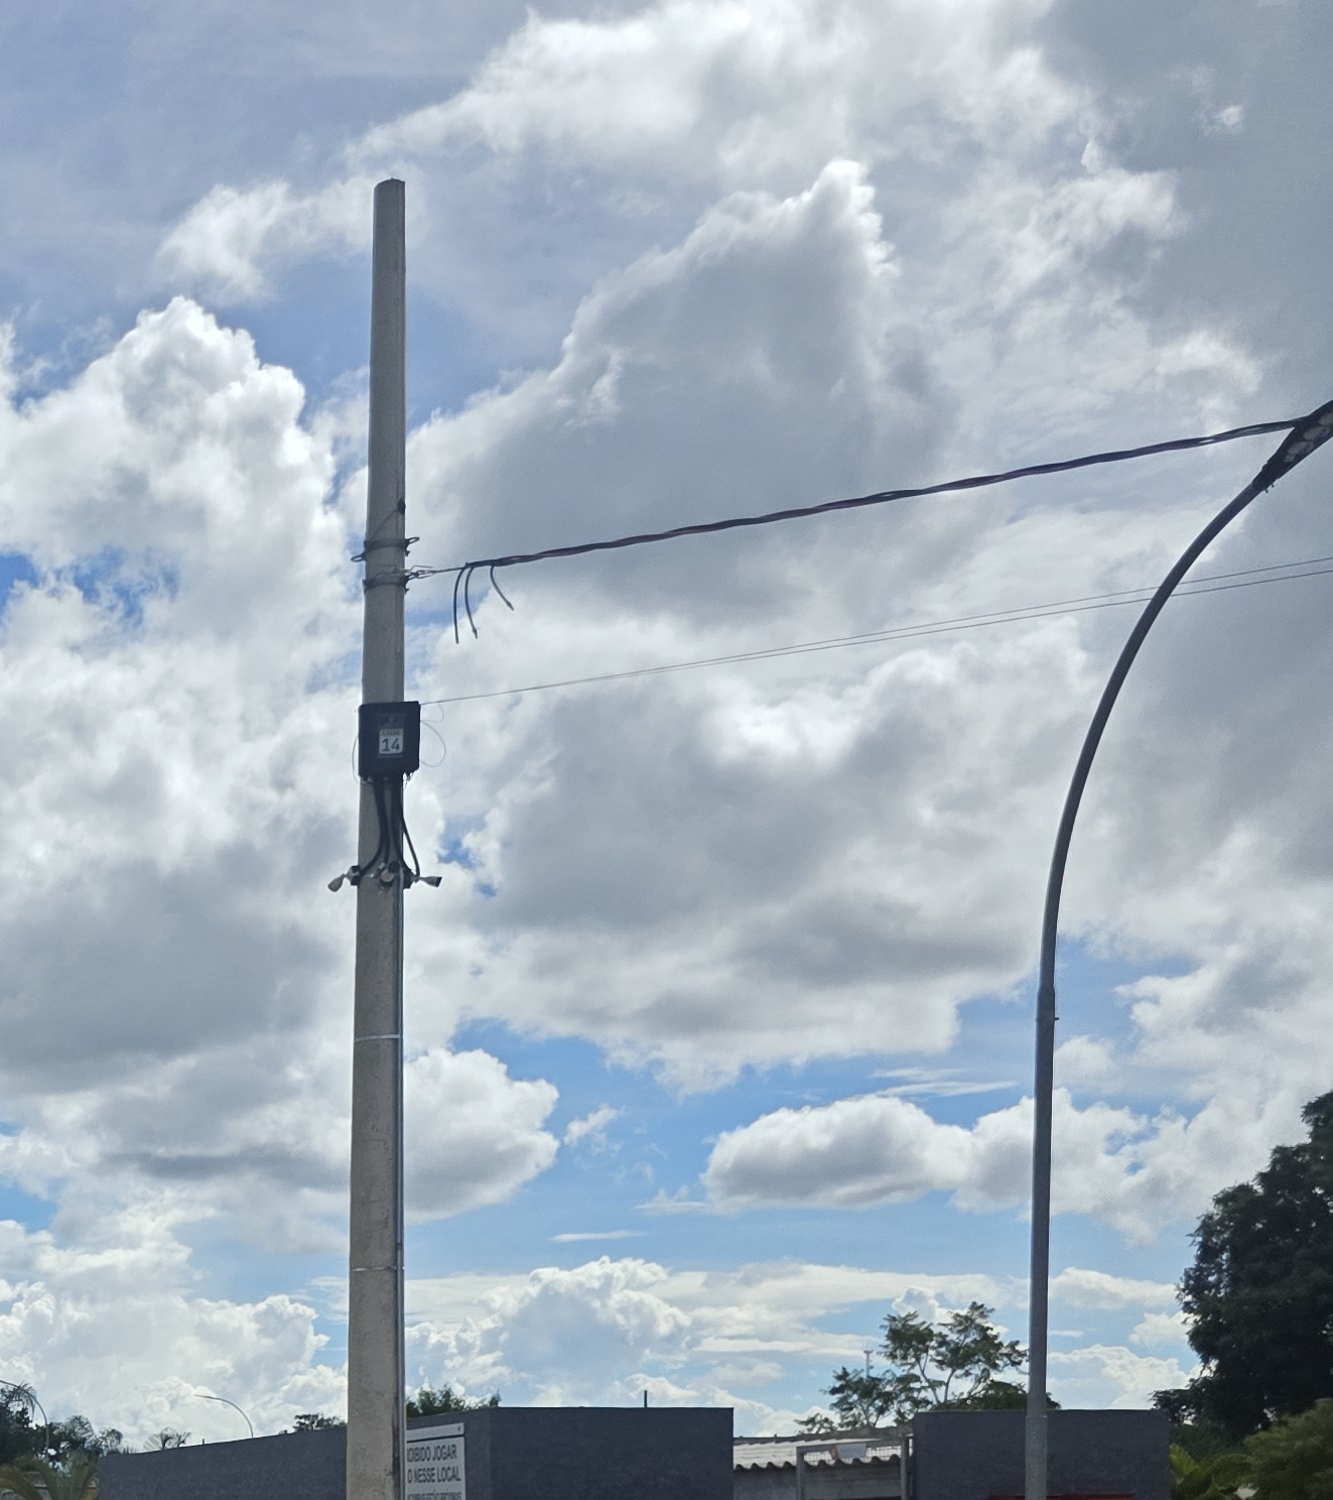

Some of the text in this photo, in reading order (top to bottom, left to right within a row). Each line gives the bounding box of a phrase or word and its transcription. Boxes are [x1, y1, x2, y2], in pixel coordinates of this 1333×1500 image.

[381, 738, 400, 752] 14
[407, 1444, 457, 1463] OIBIDO JOGAR
[414, 1467, 435, 1483] NESSE
[436, 1466, 461, 1482] LOCAL
